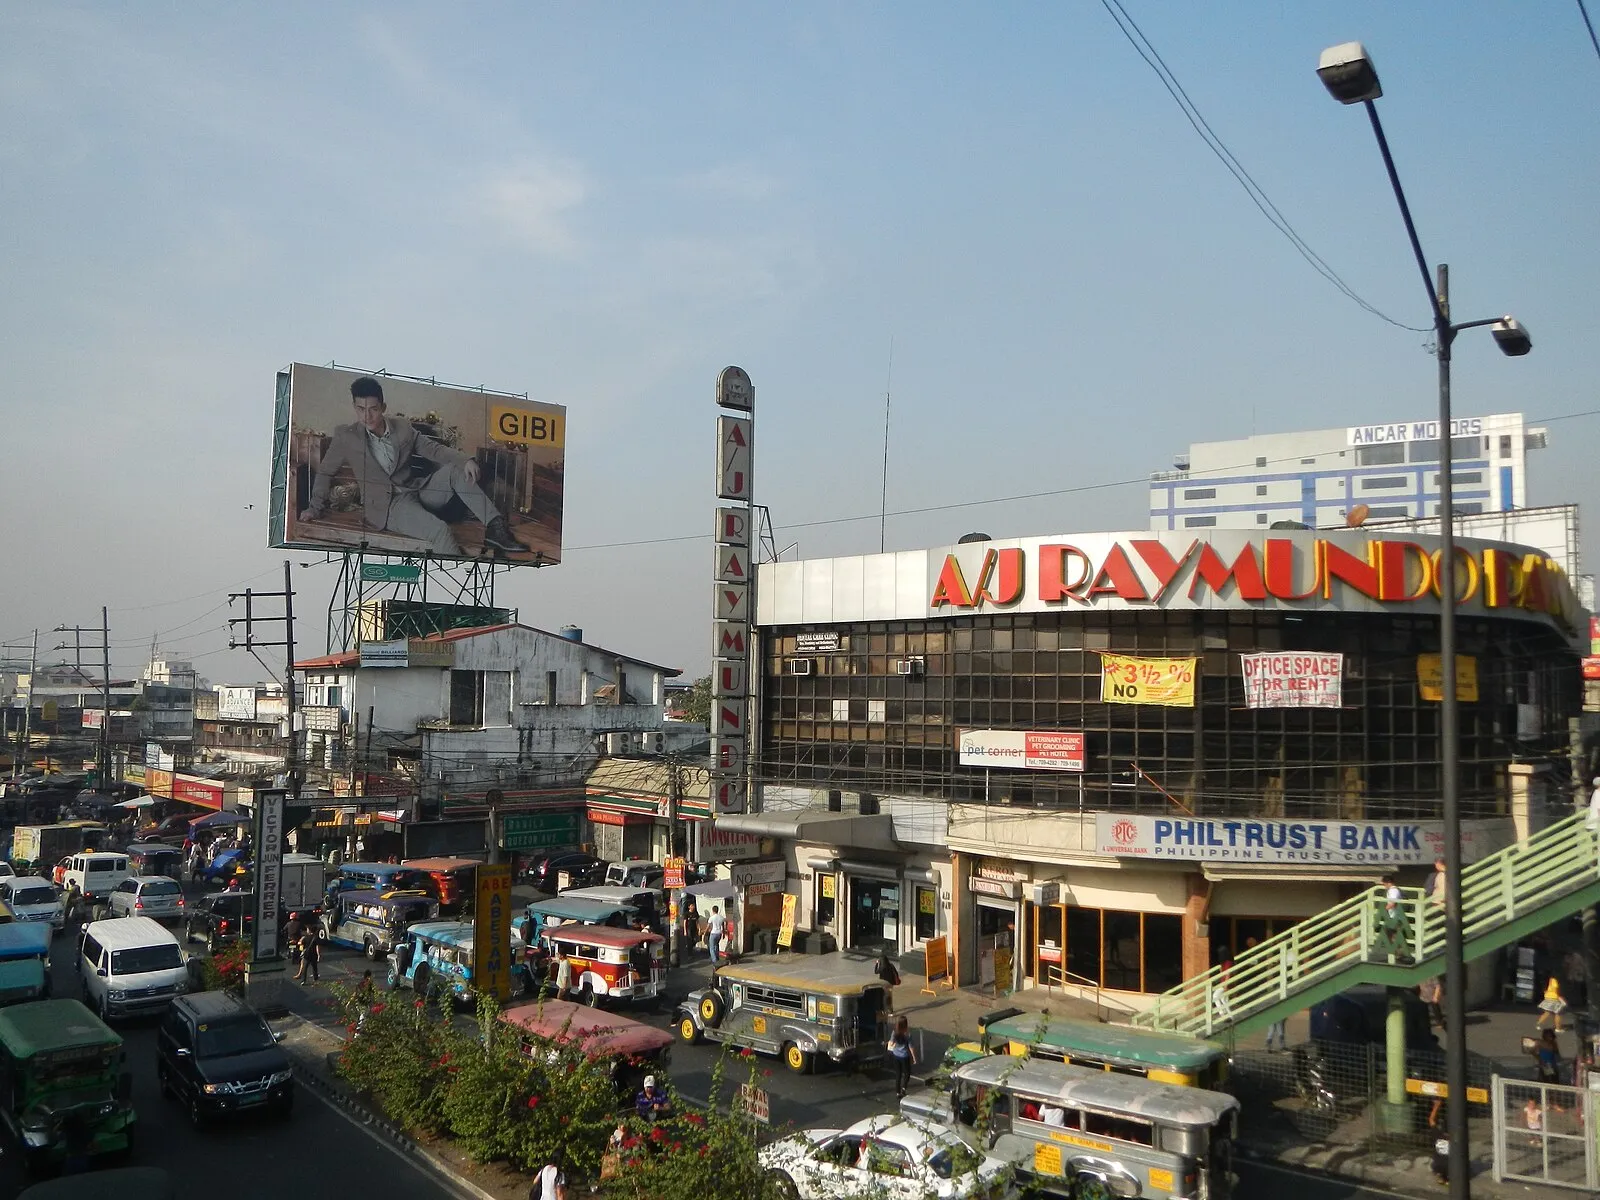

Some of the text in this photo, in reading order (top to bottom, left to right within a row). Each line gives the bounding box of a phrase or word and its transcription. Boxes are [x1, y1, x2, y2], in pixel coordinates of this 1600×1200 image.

[499, 412, 555, 442] GIBI
[1353, 418, 1482, 444] ANCAR MOORS
[1038, 537, 1480, 606] RAYMUNDO
[1244, 656, 1339, 677] OFFICE SPACE
[1113, 683, 1138, 698] NO
[1252, 677, 1330, 691] FOR RENT
[1027, 735, 1080, 745] VETERINARY CLINIC
[1031, 742, 1076, 751] PET GROOMING
[967, 745, 1023, 758] pet corner
[265, 797, 278, 852] VICTOR
[507, 835, 539, 847] QUEZON
[1154, 819, 1421, 851] PHILTRUST BANK
[1106, 846, 1133, 854] UNIVERSAL
[1154, 846, 1422, 861] PHILIPPINE TRUST COMPANY
[262, 853, 280, 864] JUN
[482, 878, 509, 890] ABE
[736, 873, 753, 886] NO
